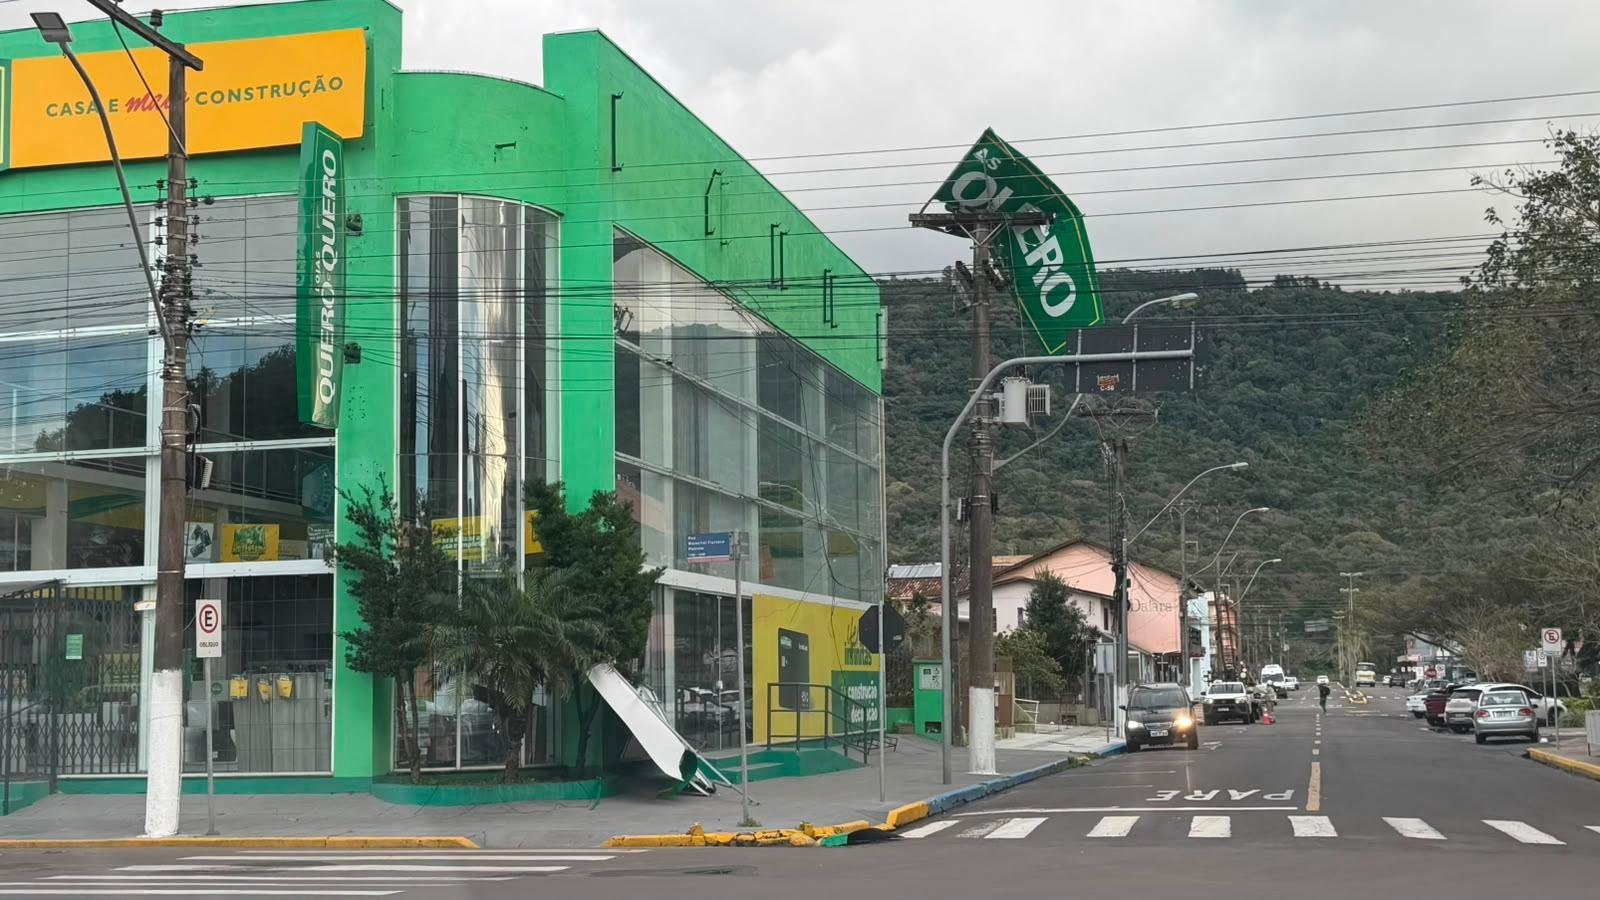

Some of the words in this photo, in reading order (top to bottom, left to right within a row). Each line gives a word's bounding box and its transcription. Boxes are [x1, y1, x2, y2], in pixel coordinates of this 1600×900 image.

[46, 100, 98, 117] CASA
[108, 99, 119, 113] E
[195, 75, 344, 106] CONSTRUÇÃO
[205, 610, 213, 627] E
[1145, 789, 1295, 801] PARE
